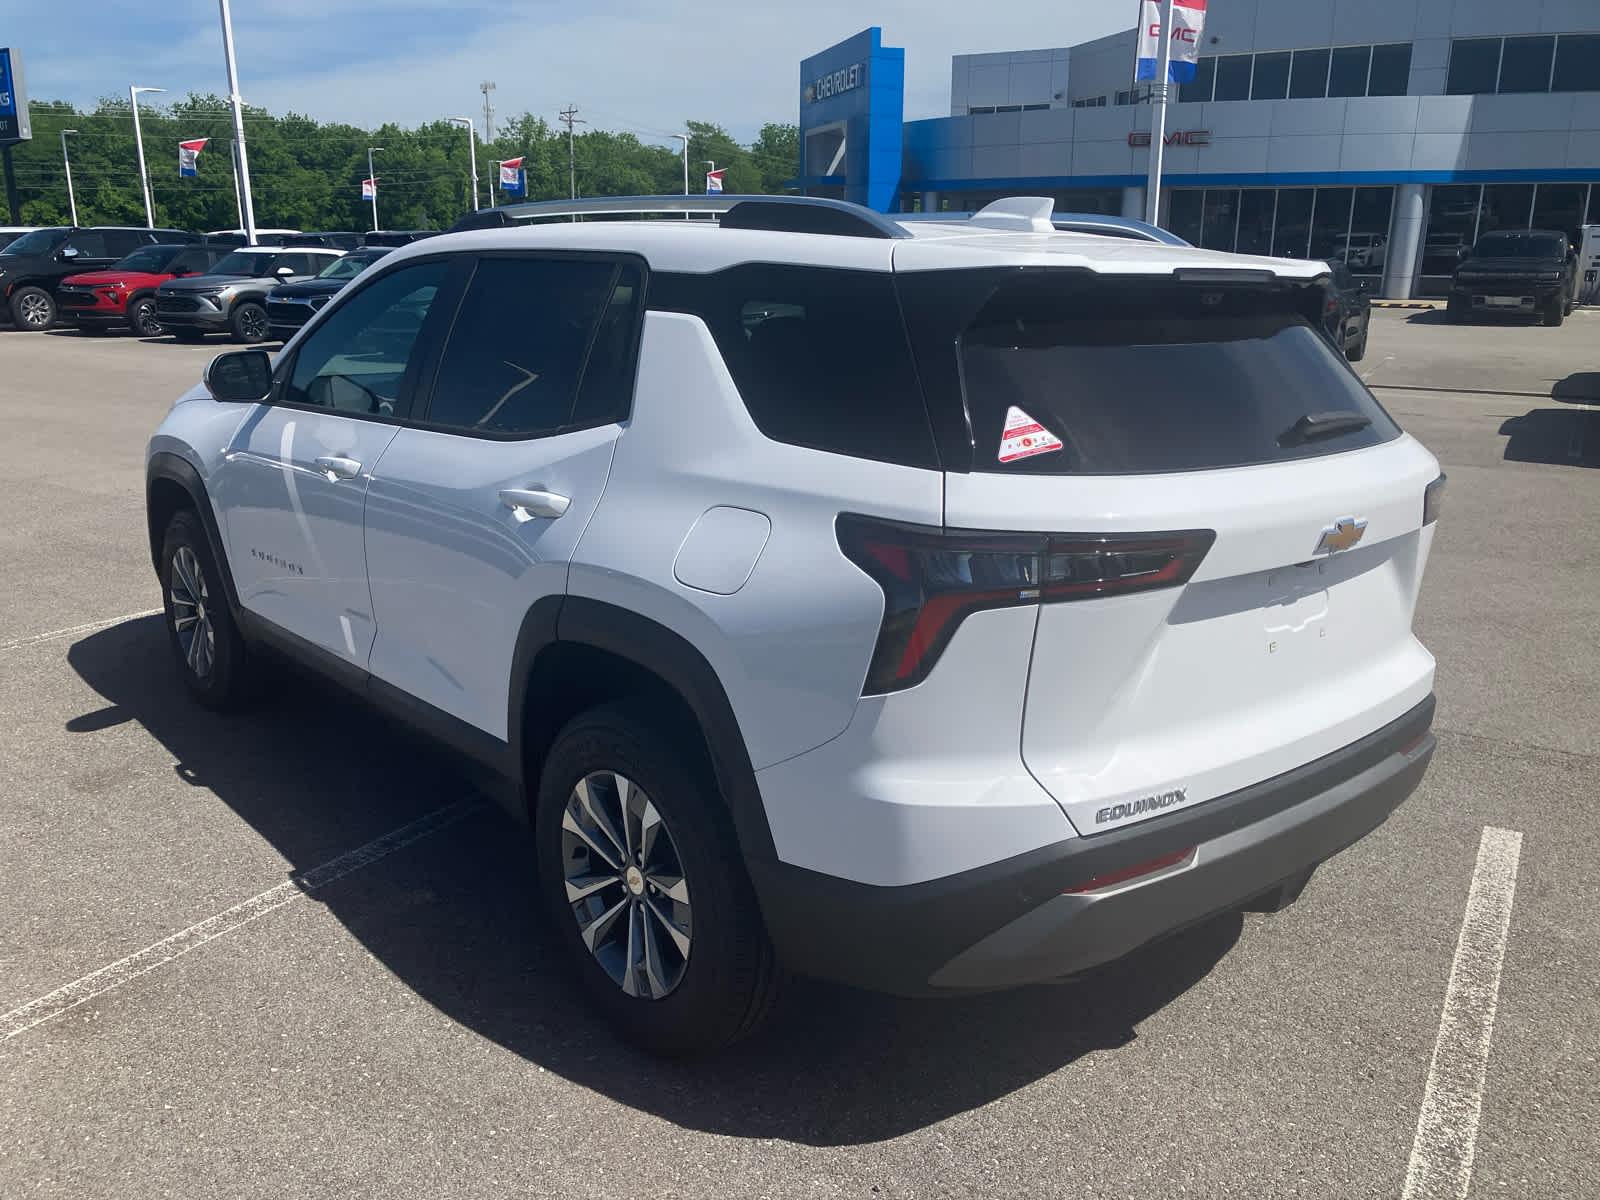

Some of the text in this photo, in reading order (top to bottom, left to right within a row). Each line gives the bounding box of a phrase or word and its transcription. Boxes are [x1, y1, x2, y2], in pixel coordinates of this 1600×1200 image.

[816, 64, 860, 100] CHEVROLET
[1128, 130, 1209, 147] GMC
[1096, 787, 1188, 824] EQUINOX
